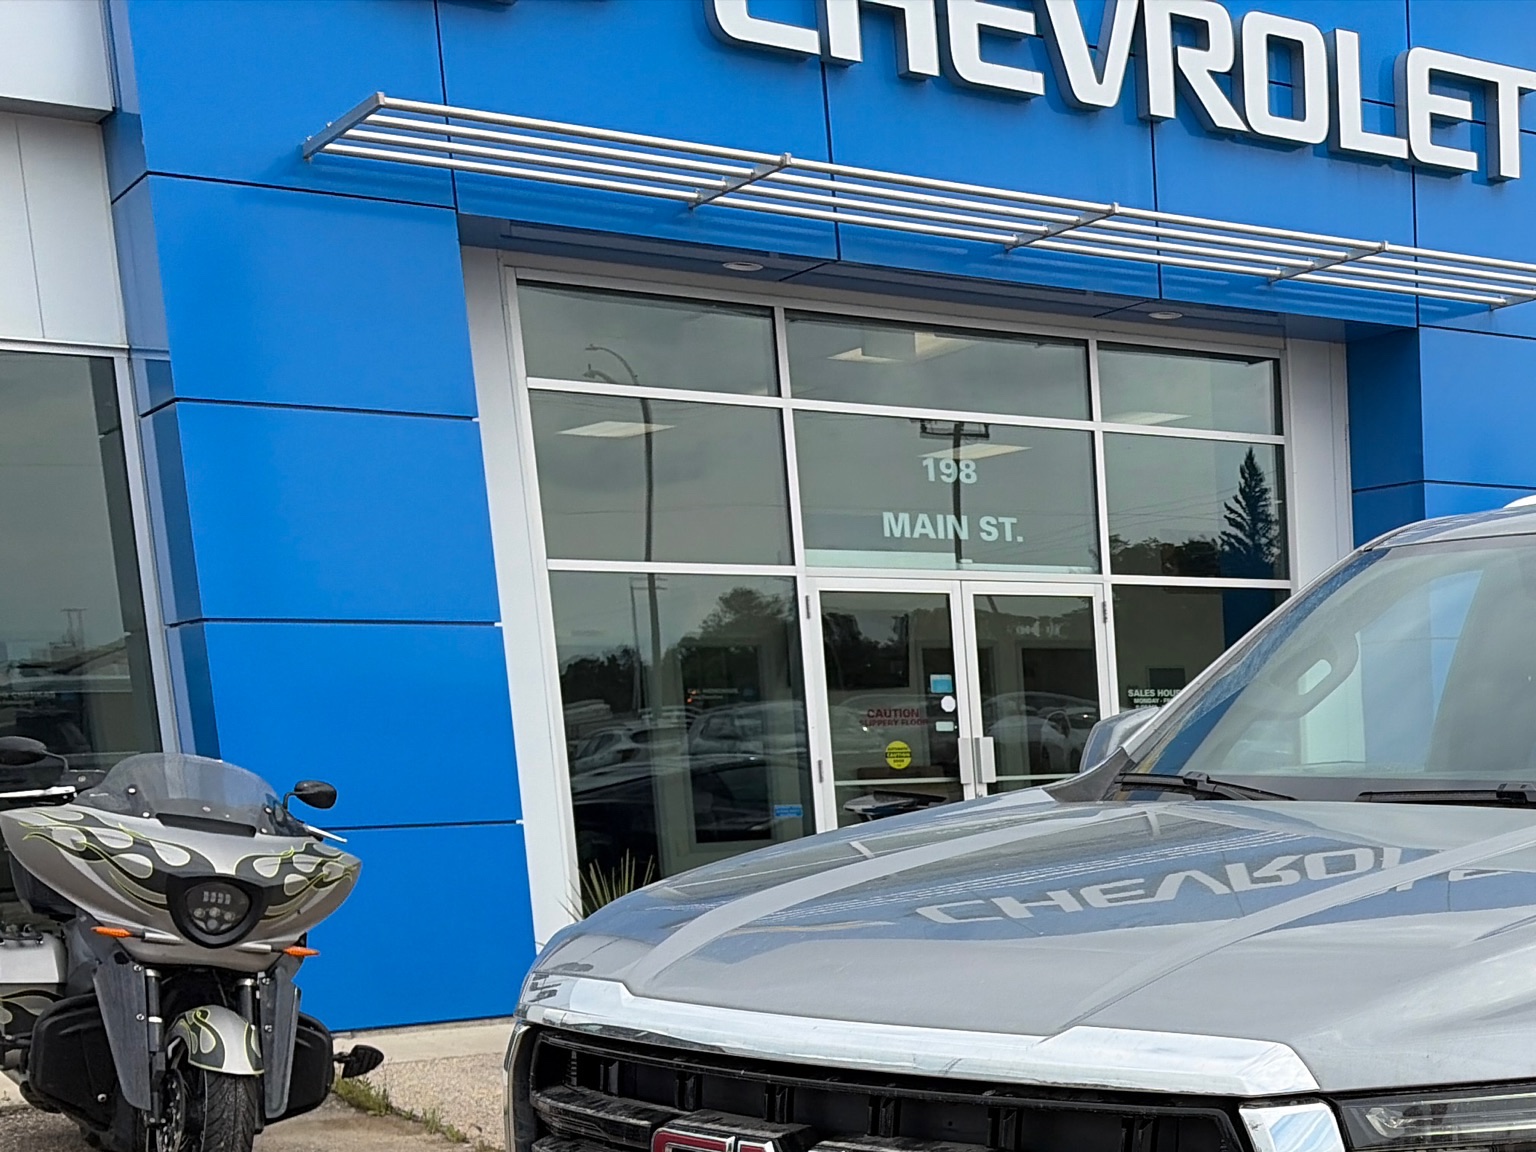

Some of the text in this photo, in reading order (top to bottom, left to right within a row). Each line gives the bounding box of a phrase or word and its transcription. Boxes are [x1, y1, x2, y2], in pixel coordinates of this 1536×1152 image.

[922, 457, 979, 485] 198
[882, 511, 1025, 544] MAIN ST.
[1128, 689, 1155, 697] SALES
[867, 708, 919, 718] CAUTION
